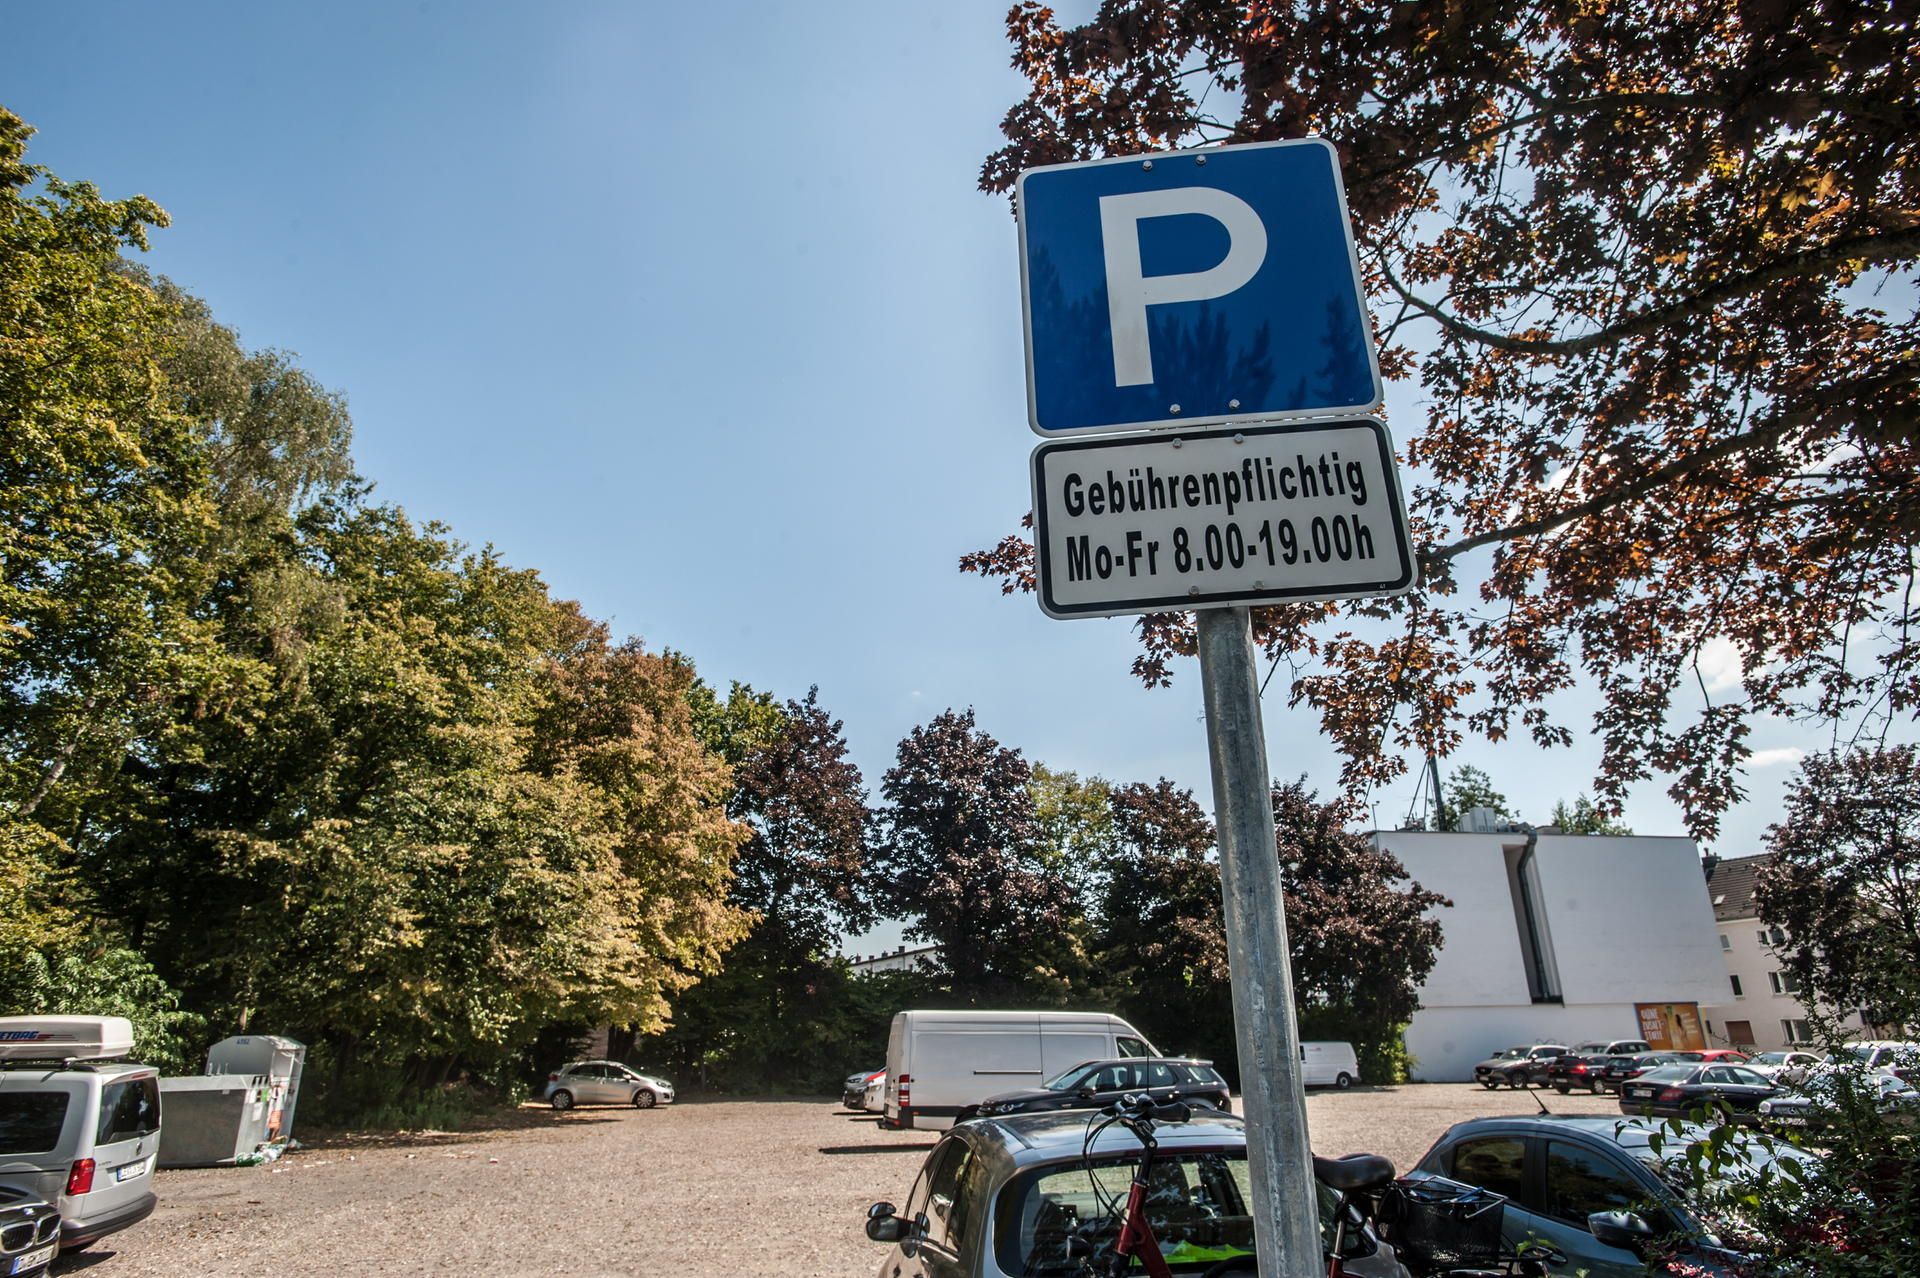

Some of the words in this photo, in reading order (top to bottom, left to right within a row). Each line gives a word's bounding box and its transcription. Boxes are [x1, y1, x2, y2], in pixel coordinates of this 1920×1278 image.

[1099, 186, 1268, 387] P
[1063, 451, 1368, 518] Gebührenpflichtig
[1065, 530, 1160, 583] Mo-Fr
[1172, 513, 1376, 574] 8.00-19.00h
